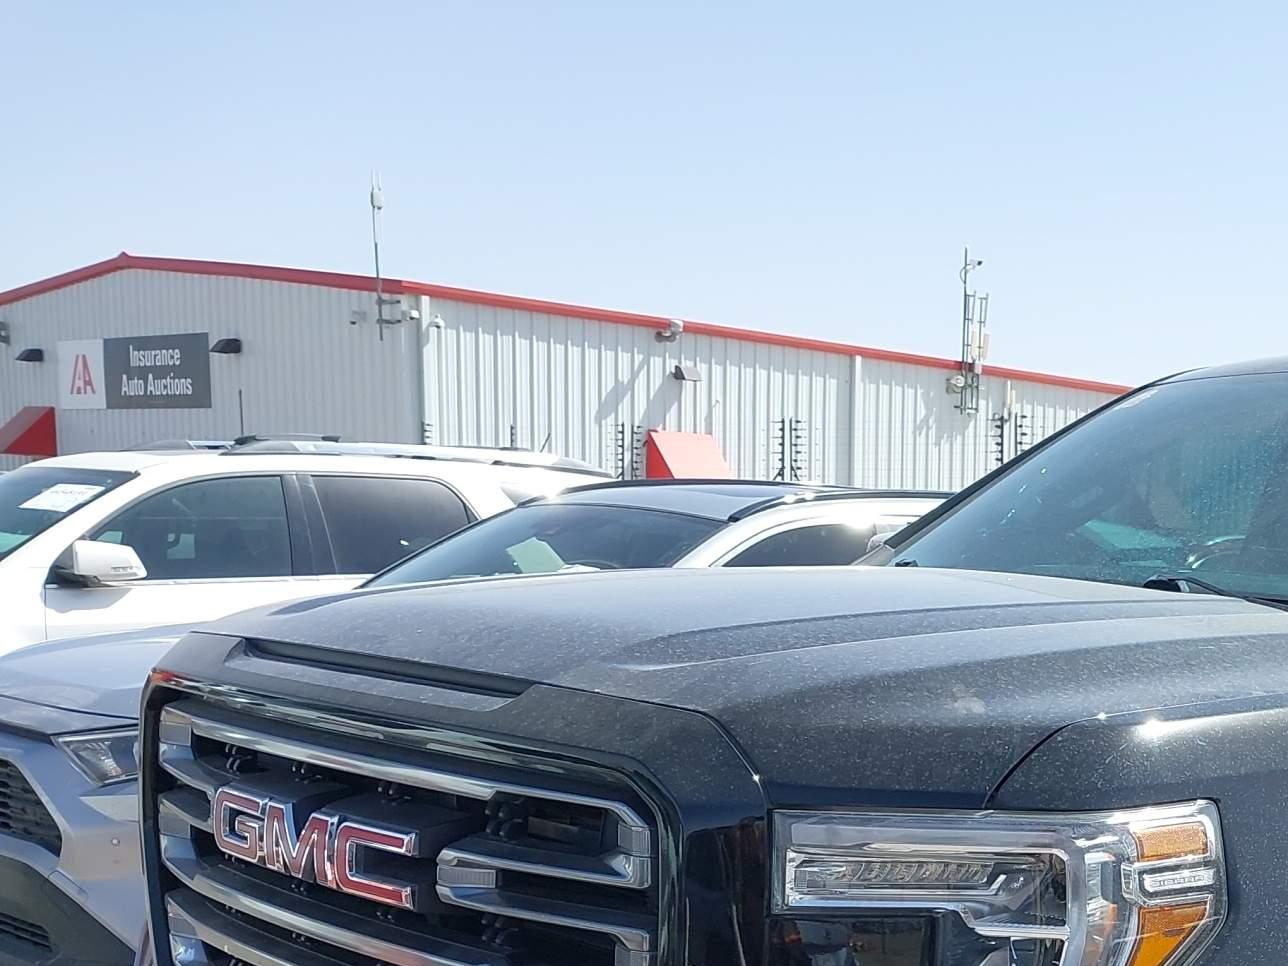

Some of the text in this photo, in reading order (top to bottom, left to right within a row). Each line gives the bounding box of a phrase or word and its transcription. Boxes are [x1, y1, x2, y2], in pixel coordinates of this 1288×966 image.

[129, 344, 181, 367] Insurance
[121, 372, 193, 396] Auto Auctions
[213, 787, 417, 910] GMC
